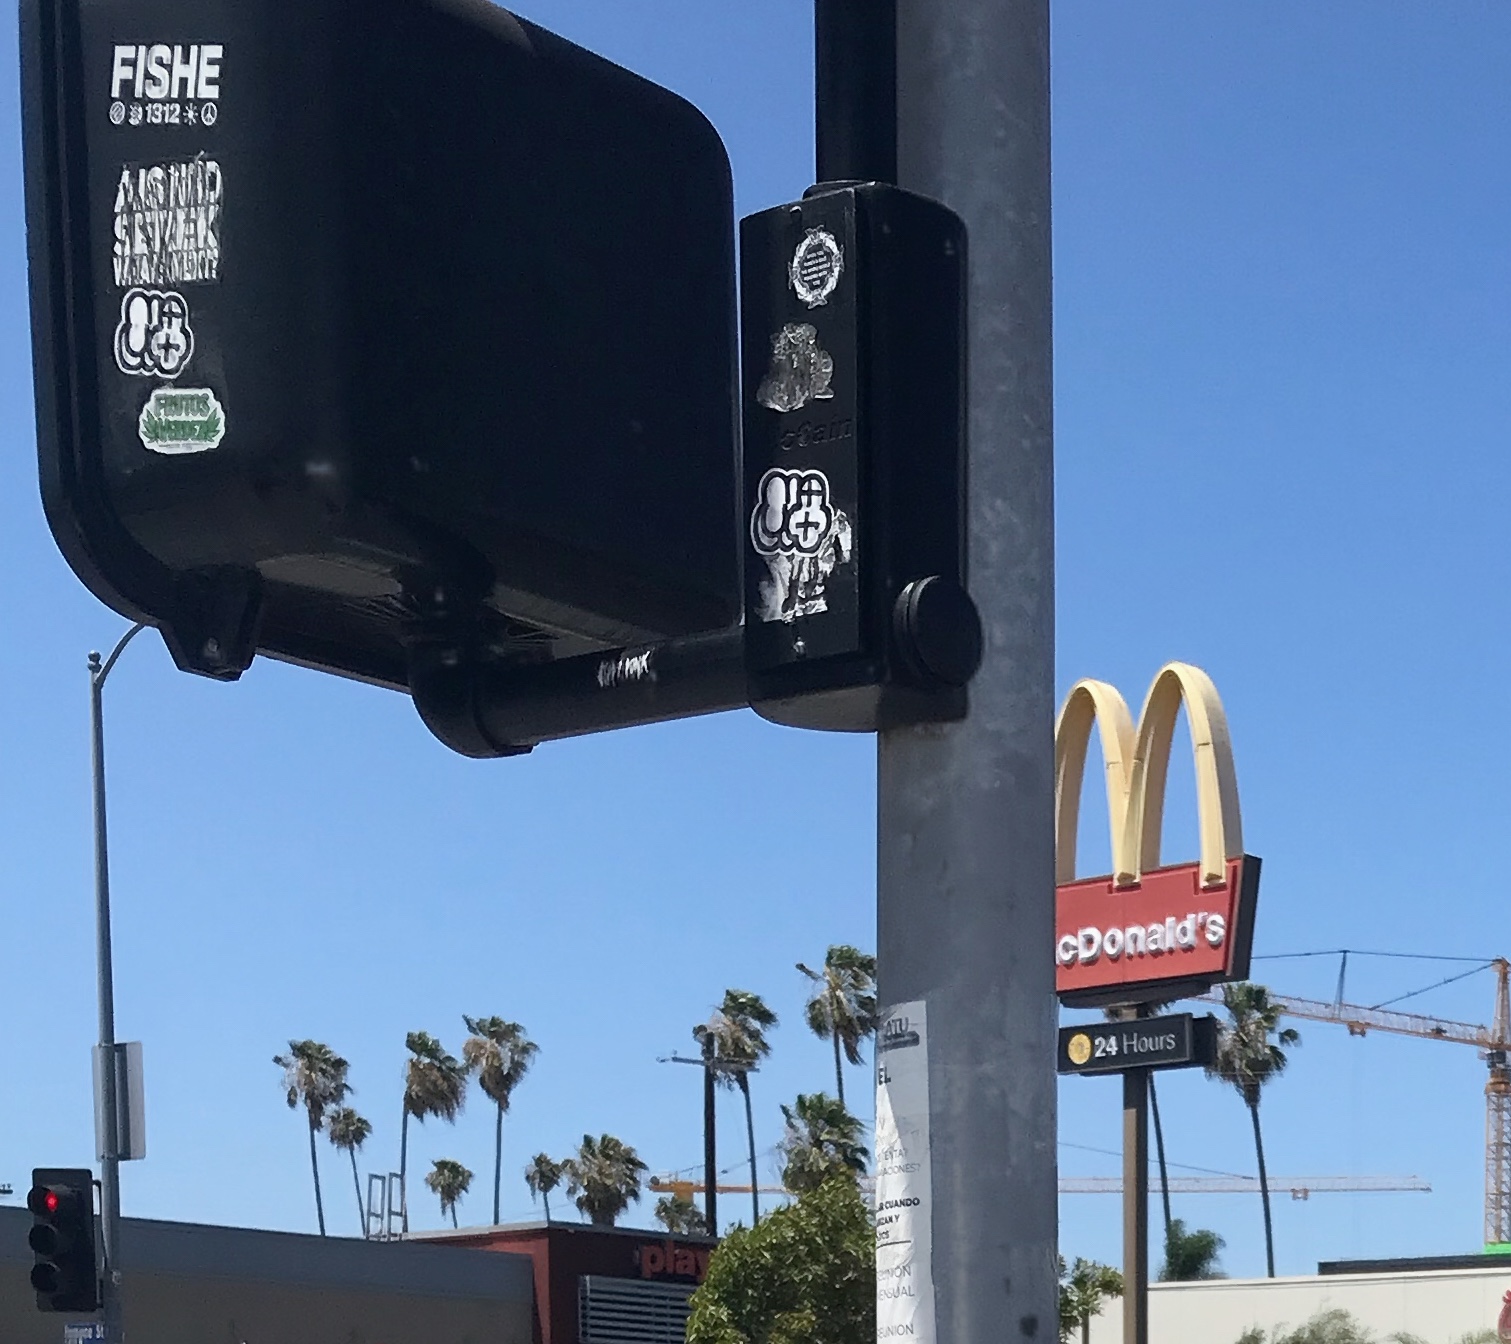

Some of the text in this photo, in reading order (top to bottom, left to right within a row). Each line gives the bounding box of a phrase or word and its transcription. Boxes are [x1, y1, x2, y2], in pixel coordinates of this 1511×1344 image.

[110, 44, 223, 99] FISHE
[145, 102, 180, 124] 1312
[1056, 911, 1226, 966] cDonald's
[1094, 1031, 1176, 1058] 24 Hours
